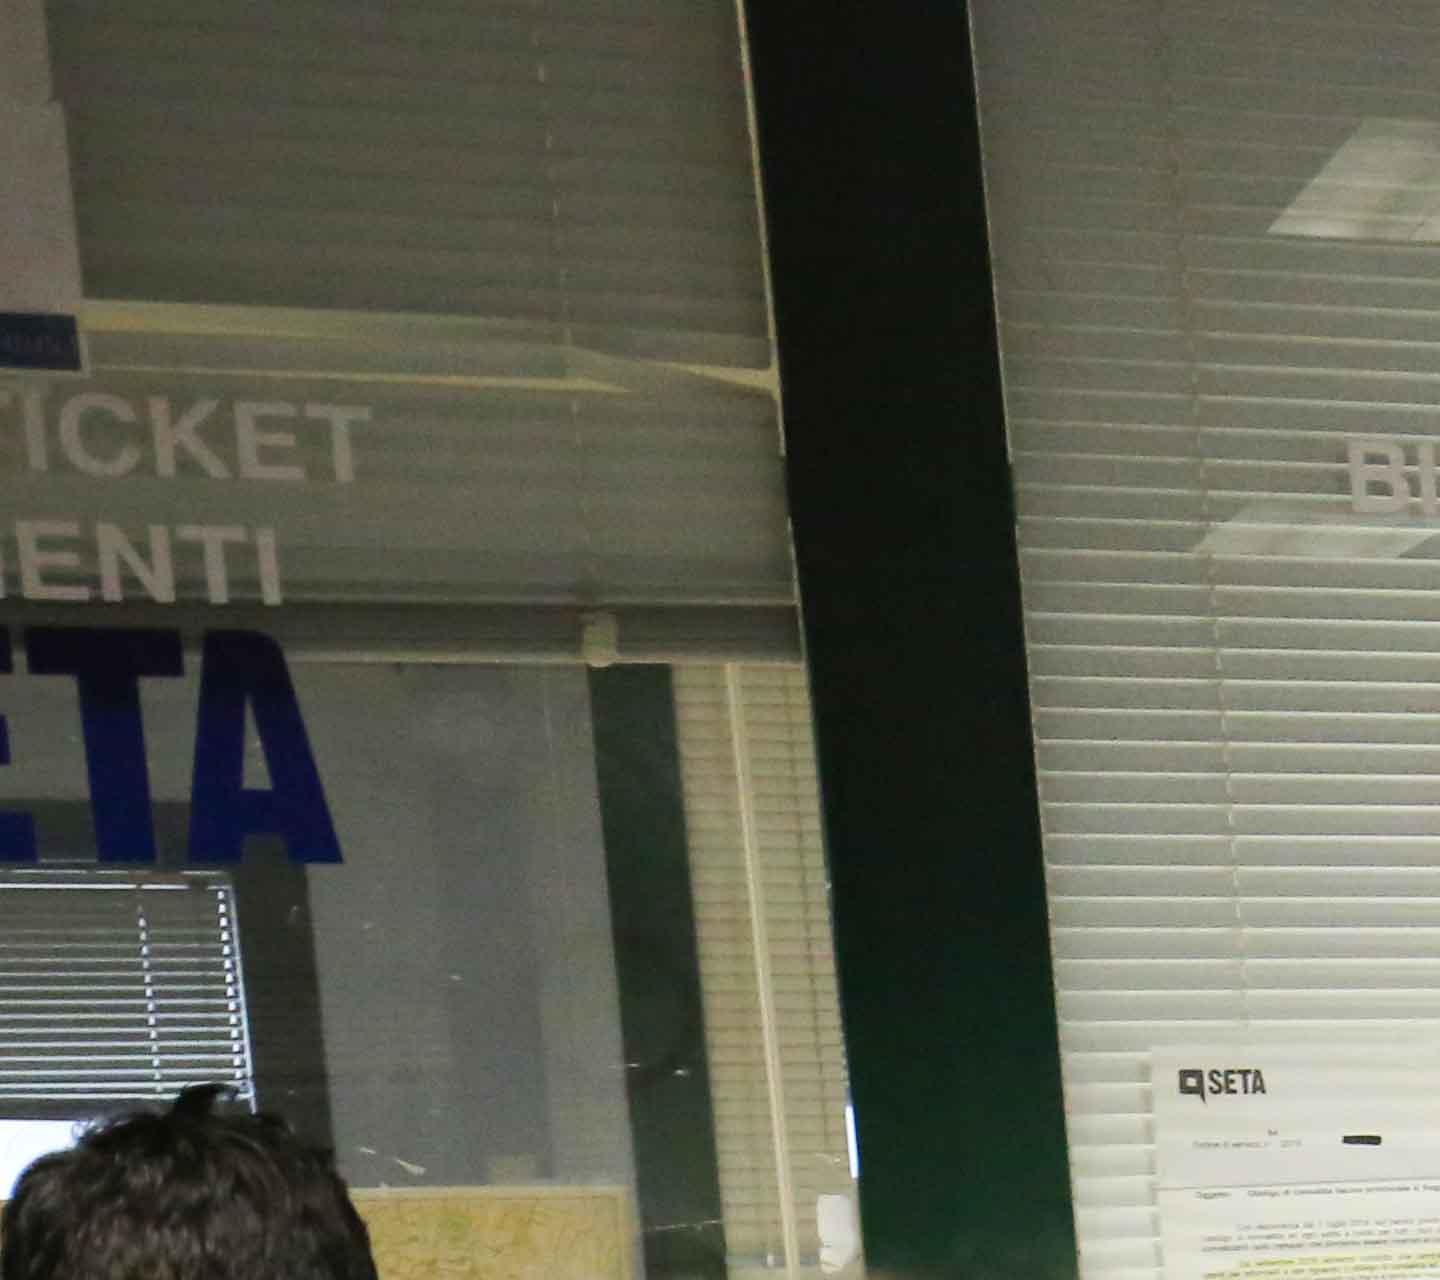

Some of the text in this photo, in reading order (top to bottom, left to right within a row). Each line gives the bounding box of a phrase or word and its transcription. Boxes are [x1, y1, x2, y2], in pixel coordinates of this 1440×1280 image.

[0, 393, 372, 484] ICKET
[0, 520, 284, 606] ENTI
[1208, 1068, 1267, 1096] SETA
